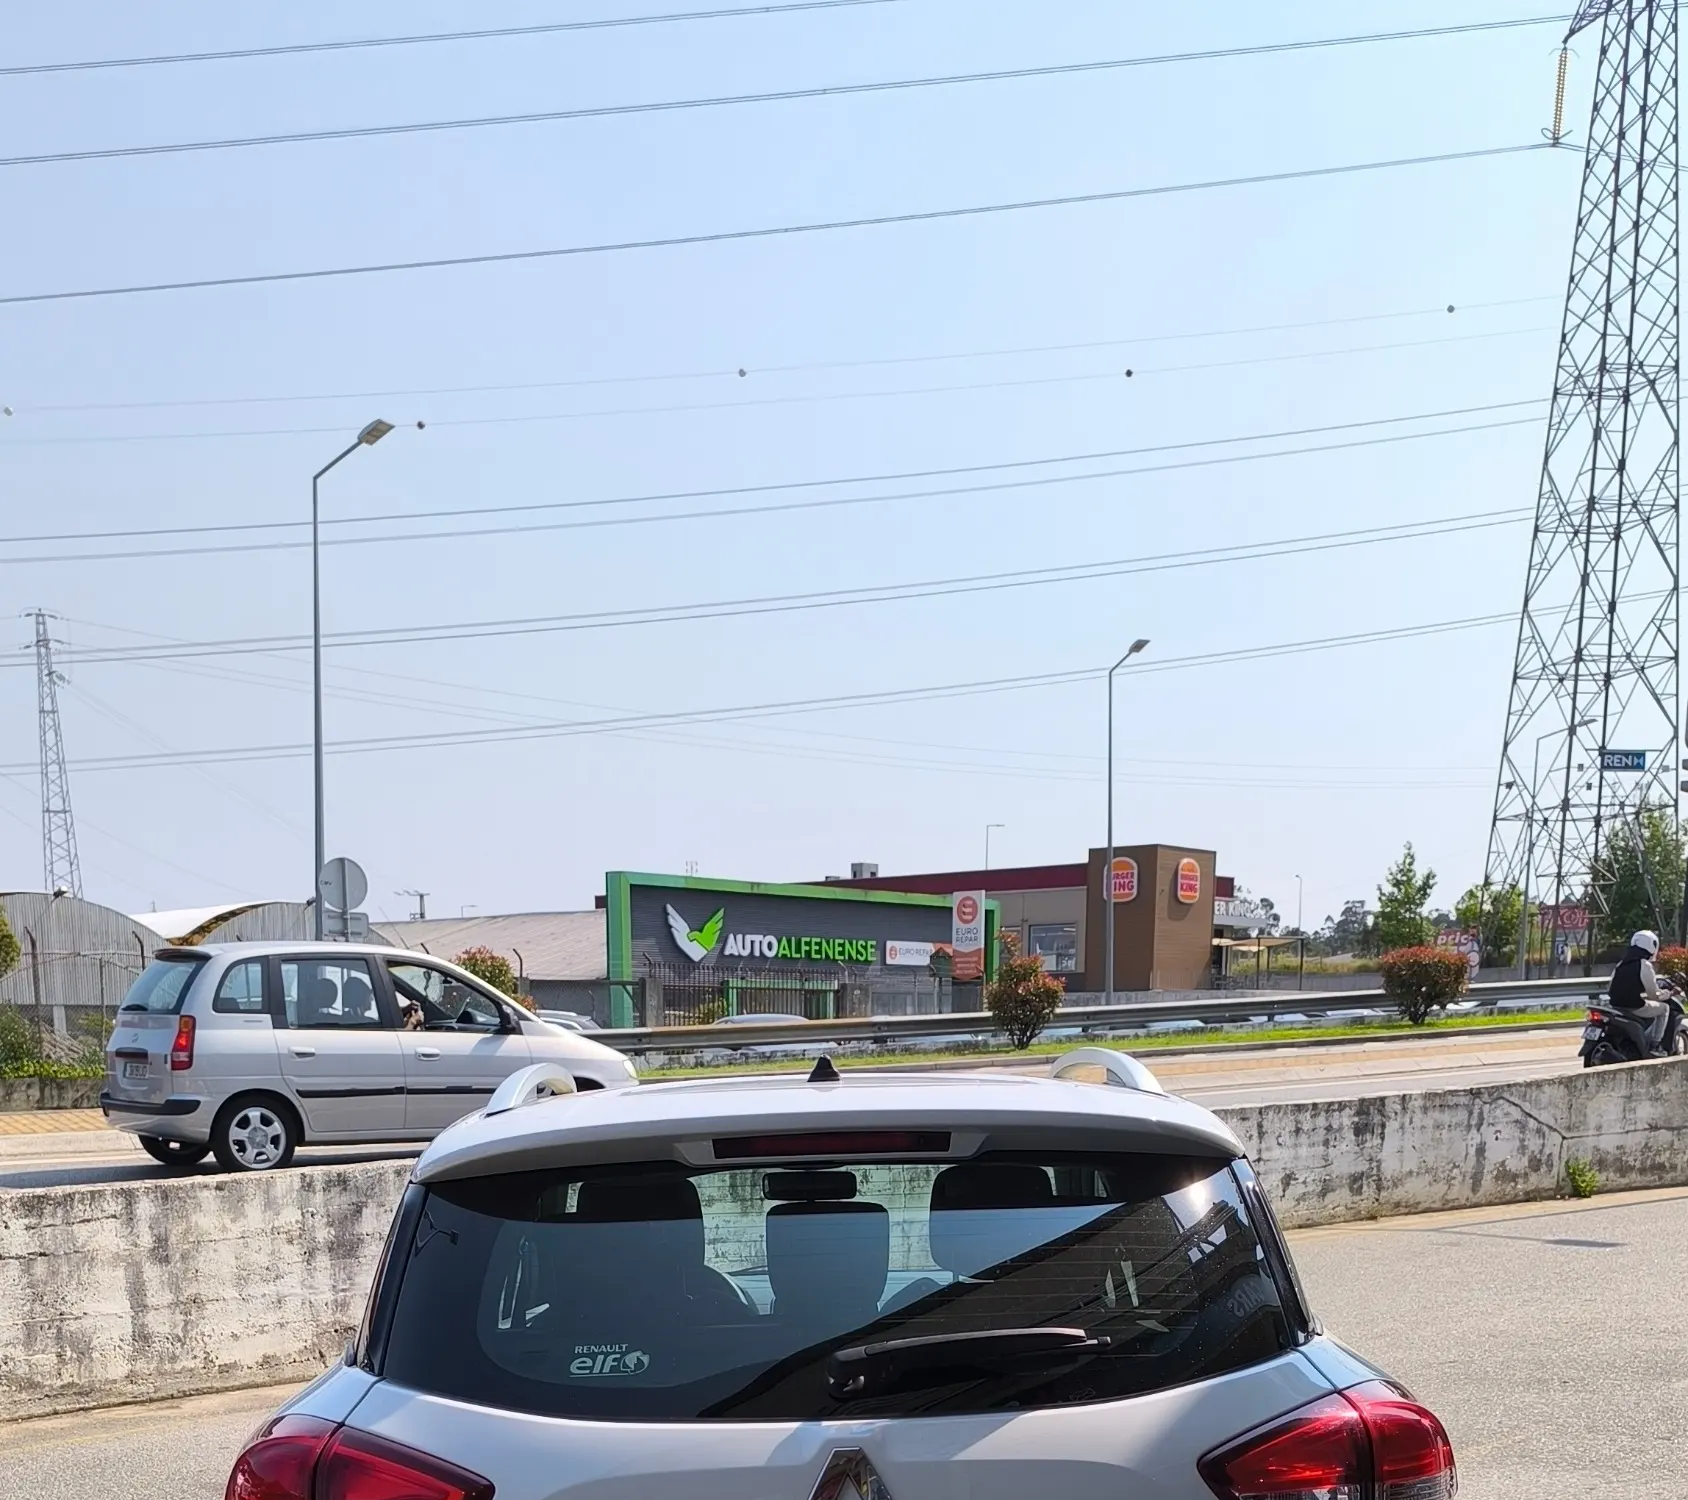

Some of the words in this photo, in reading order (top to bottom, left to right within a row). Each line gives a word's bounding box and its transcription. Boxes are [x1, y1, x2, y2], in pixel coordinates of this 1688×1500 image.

[1603, 754, 1633, 767] REN
[1111, 871, 1135, 881] URGER
[1180, 882, 1199, 894] KING
[955, 927, 979, 936] EURO
[955, 935, 979, 944] REPAR
[899, 947, 915, 956] EURO
[574, 1343, 629, 1354] RENAULT
[569, 1353, 621, 1374] elf
